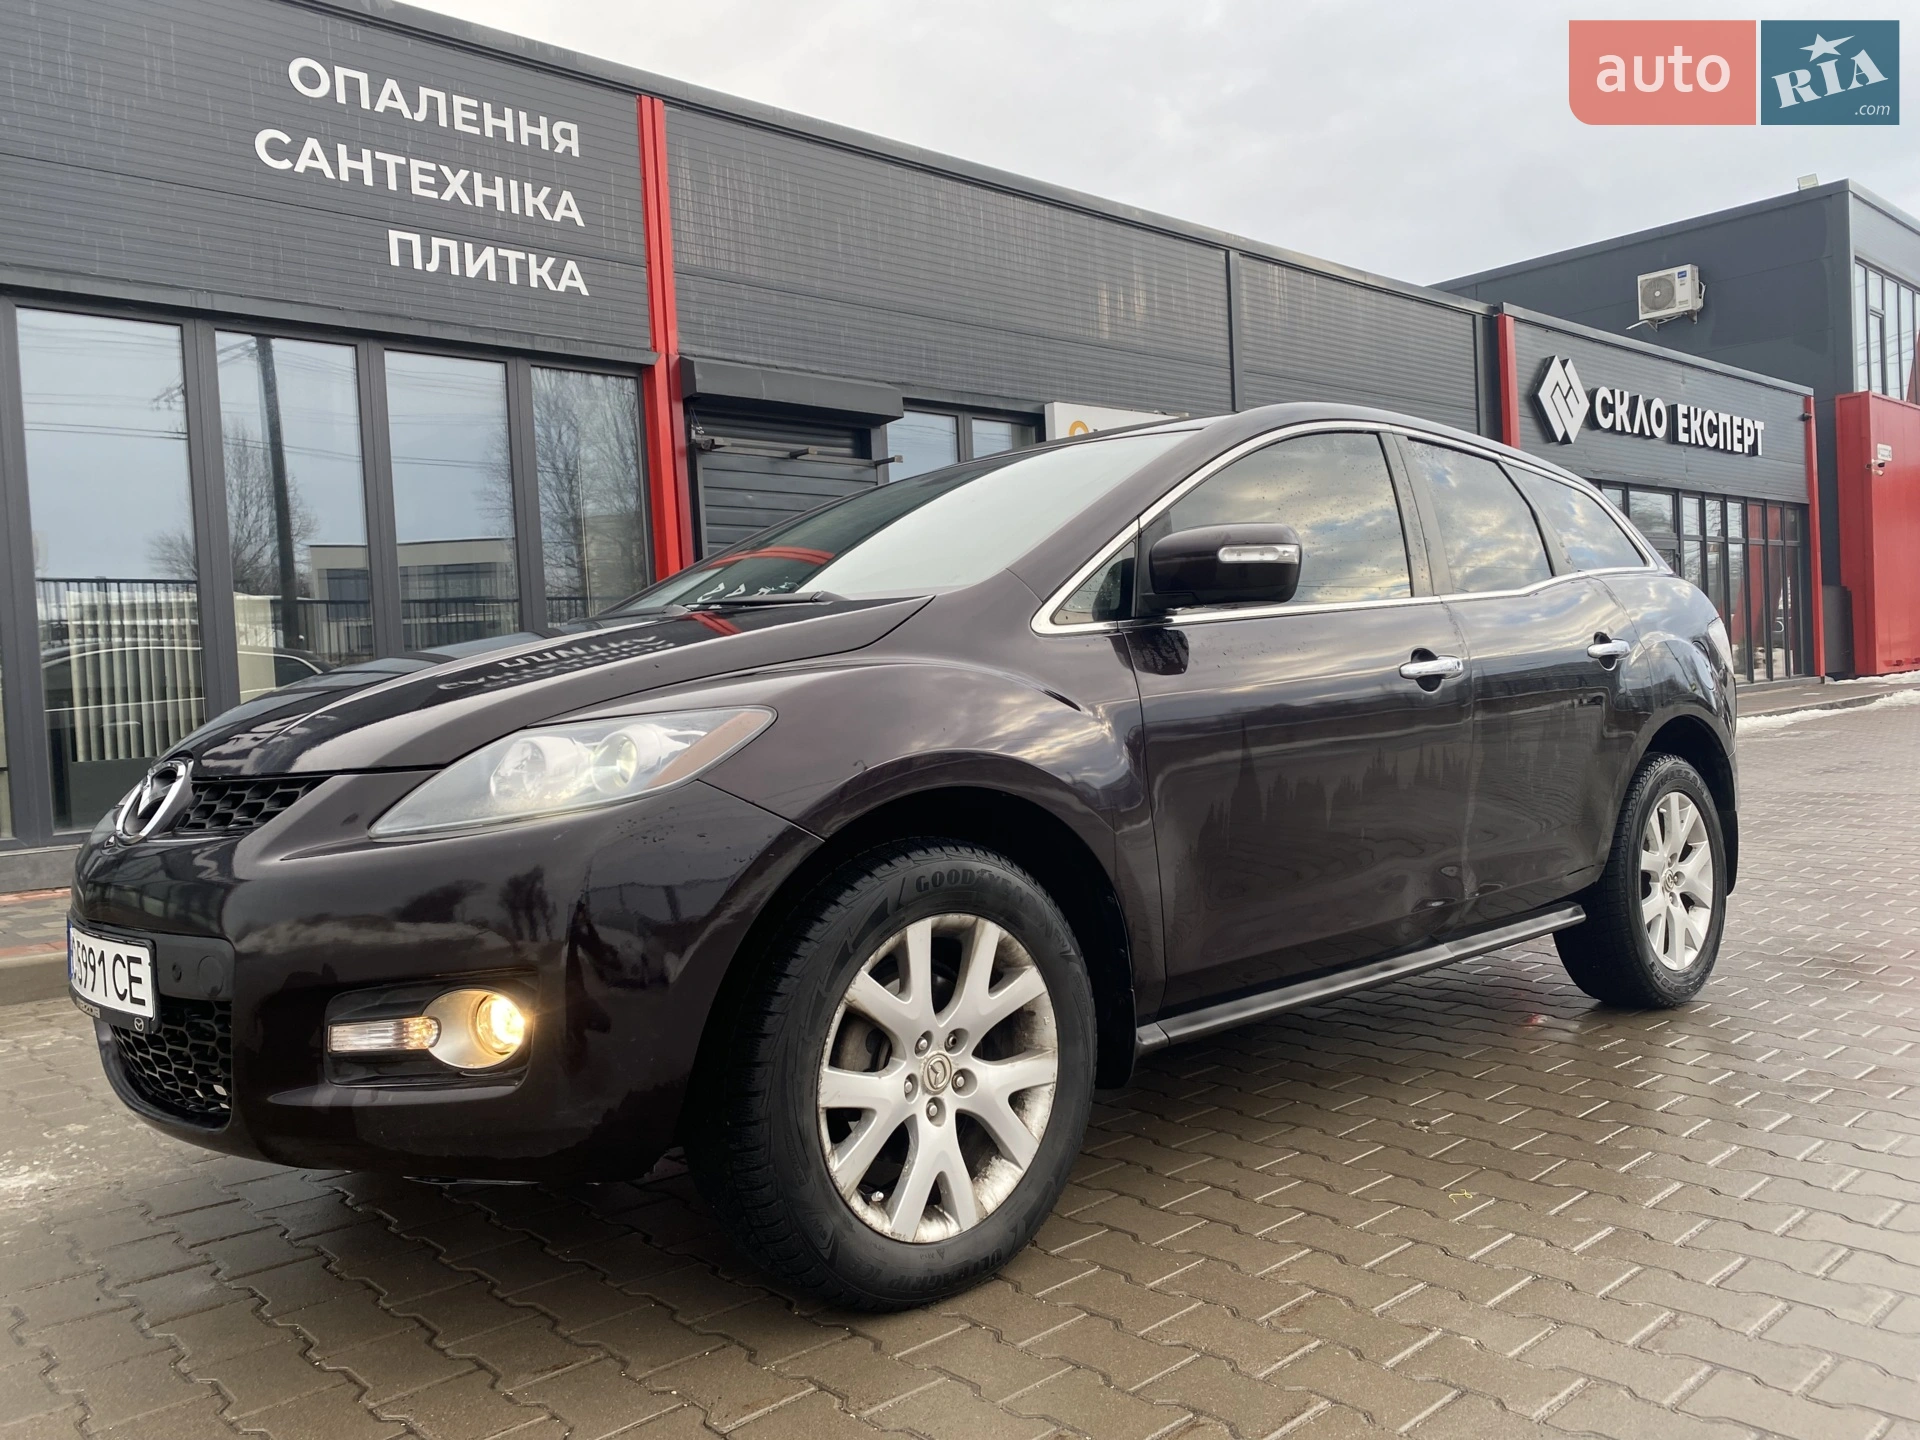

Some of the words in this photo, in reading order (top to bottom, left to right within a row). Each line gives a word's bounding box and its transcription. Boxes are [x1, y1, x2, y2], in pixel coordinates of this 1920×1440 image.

[288, 57, 580, 157] ОПАЛЕННЯ
[254, 128, 585, 227] САНТЕХНІКА
[388, 229, 590, 296] ПЛИТКА
[1593, 386, 1668, 439] СКЛО
[1675, 403, 1765, 456] ЕКСПЕРТ
